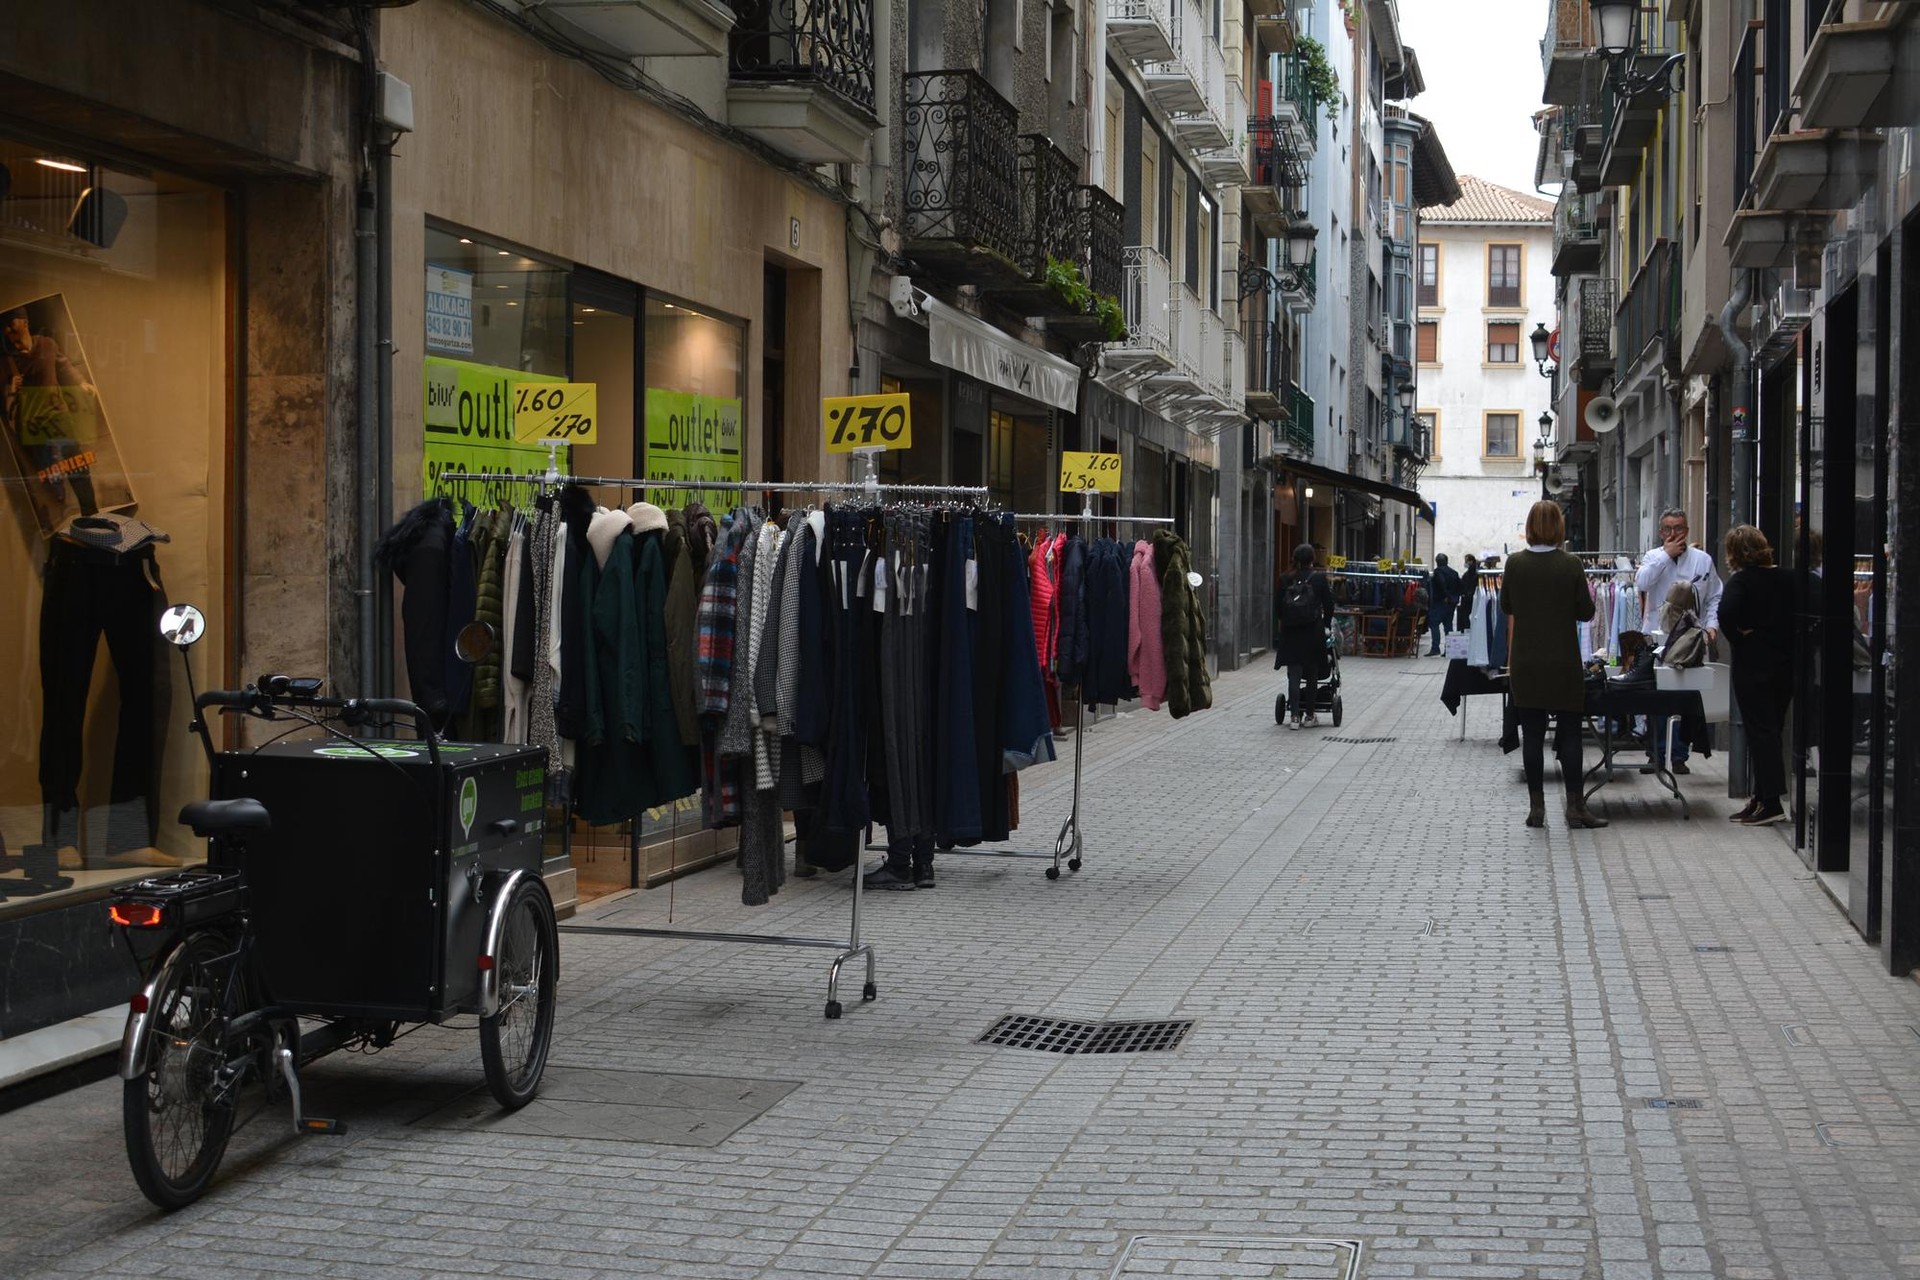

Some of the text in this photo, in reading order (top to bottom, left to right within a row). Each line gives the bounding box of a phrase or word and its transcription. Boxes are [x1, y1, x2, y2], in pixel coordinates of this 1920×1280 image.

[427, 314, 441, 334] 943
[442, 317, 451, 336] 82
[453, 319, 462, 337] 90
[458, 379, 511, 440] outl
[516, 388, 564, 414] %60
[546, 414, 592, 438] %70
[669, 403, 719, 454] outlet
[829, 404, 906, 445] %70
[38, 450, 96, 482] PIONIER
[1087, 455, 1120, 471] %60
[1062, 471, 1096, 490] %50
